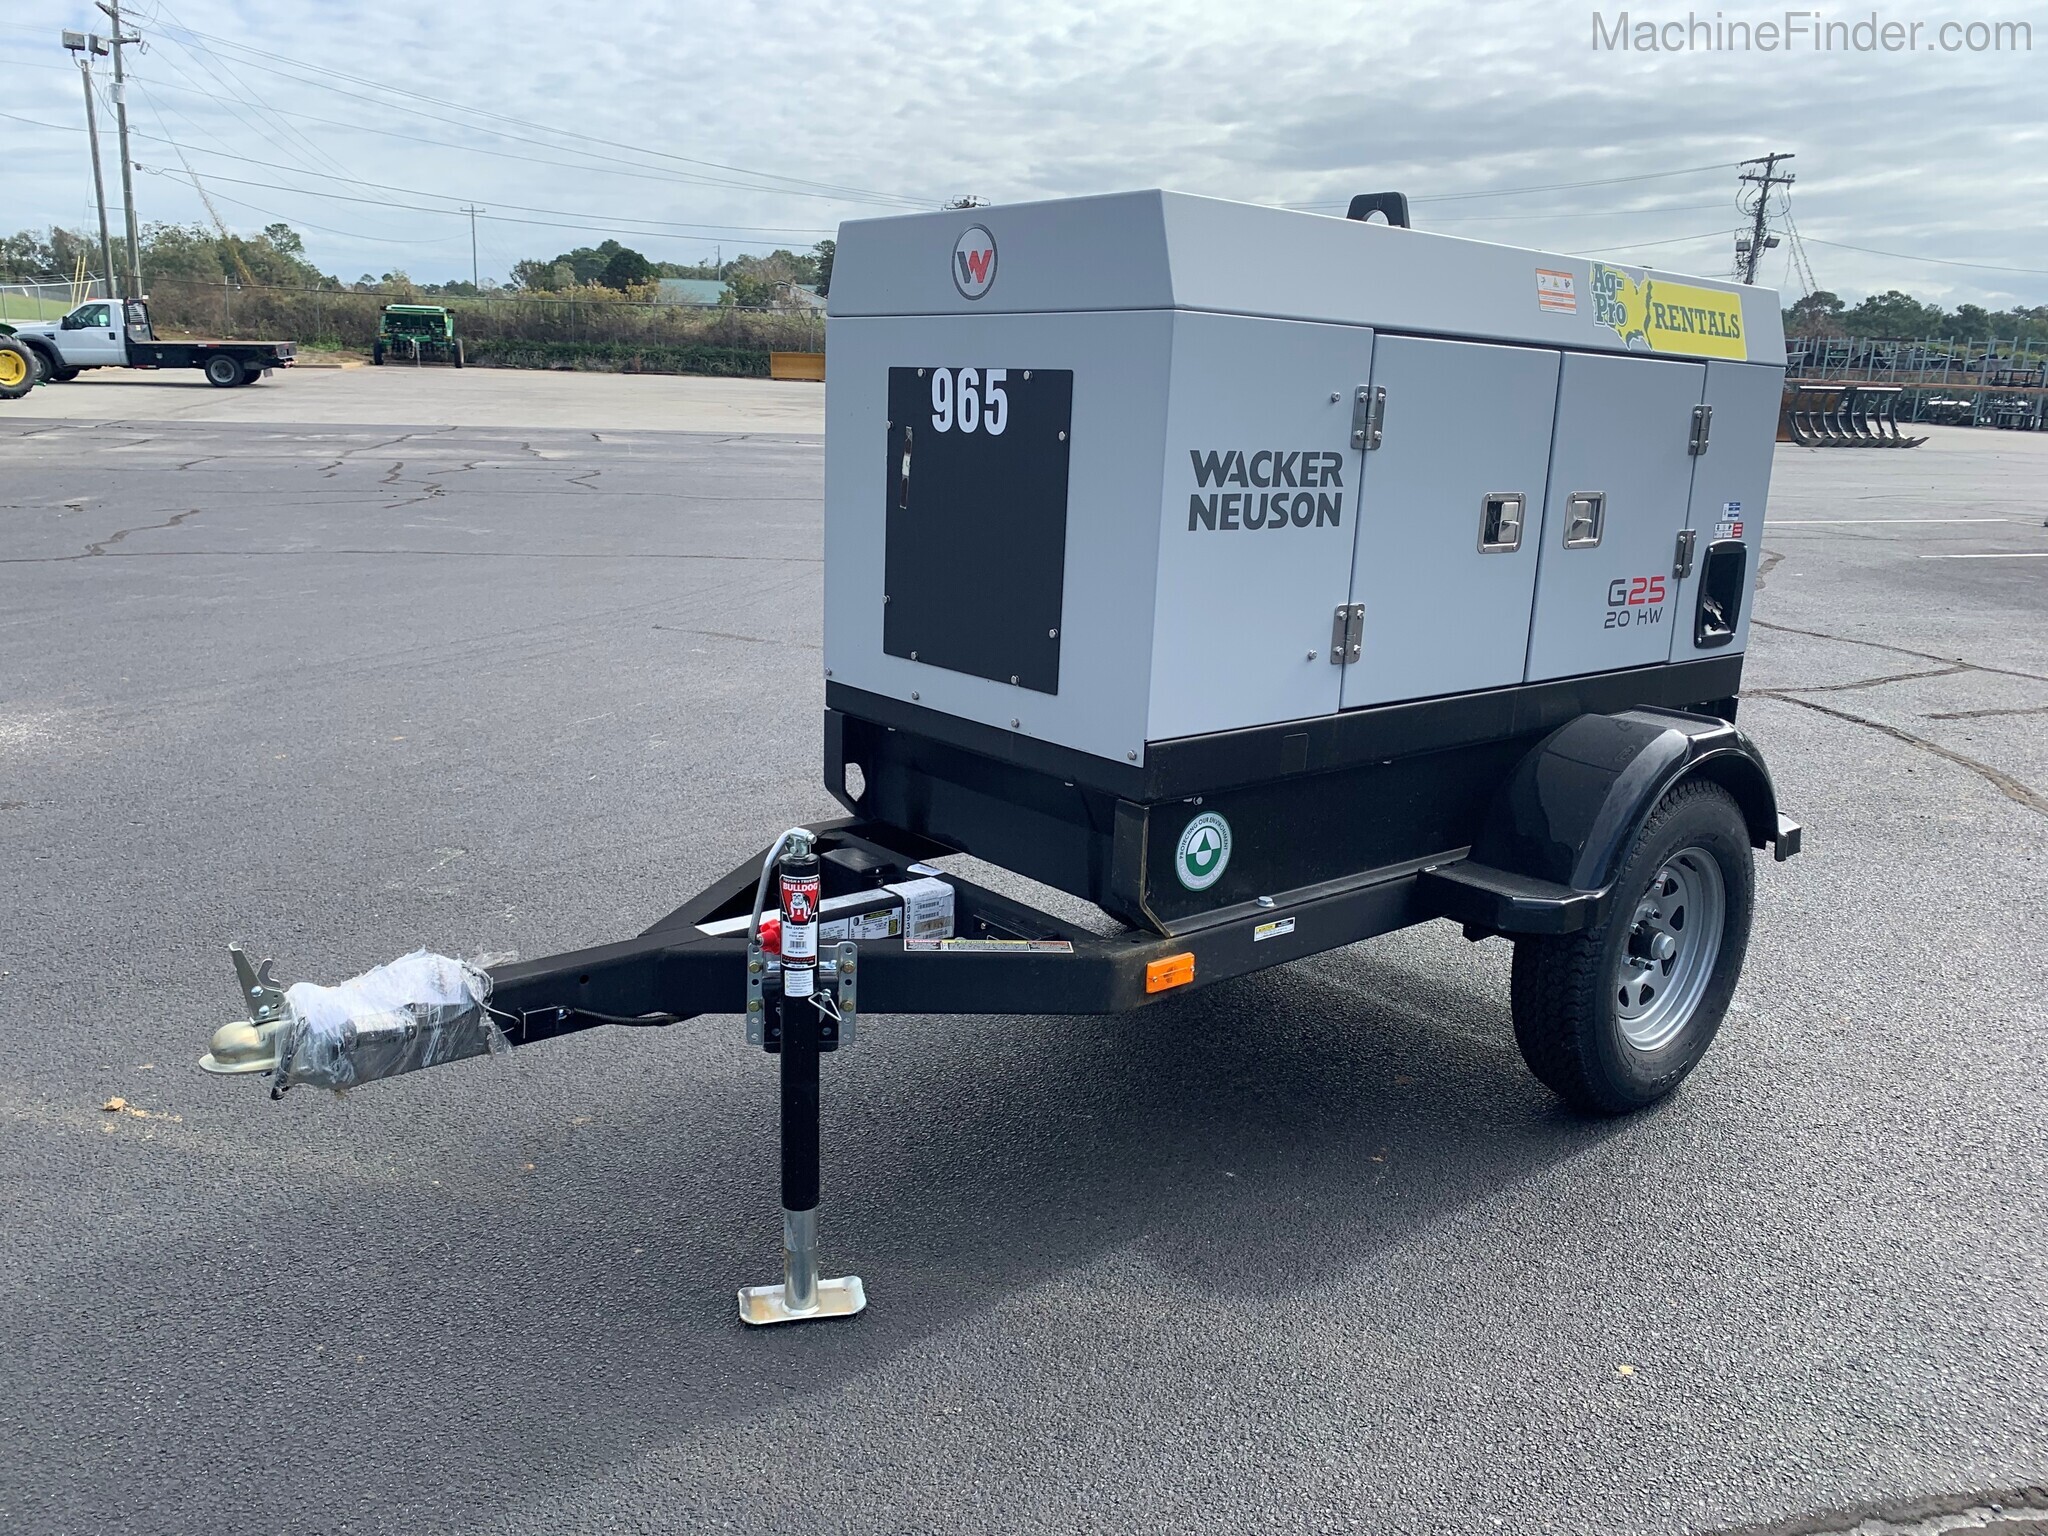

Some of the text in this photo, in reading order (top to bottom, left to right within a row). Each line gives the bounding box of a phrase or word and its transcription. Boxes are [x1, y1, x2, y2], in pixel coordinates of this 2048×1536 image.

[1592, 263, 1624, 300] Ag-
[1595, 293, 1627, 325] Pro
[1652, 302, 1740, 339] RENTALS
[931, 367, 1008, 436] 965
[1189, 450, 1344, 488] WACKER
[1188, 492, 1343, 531] NEUSON
[1608, 576, 1665, 607] G25
[1604, 610, 1630, 629] 20
[1179, 822, 1199, 860] PROTECTING
[1209, 817, 1228, 851] ENVIRONMENT
[783, 882, 818, 892] BULLDOG
